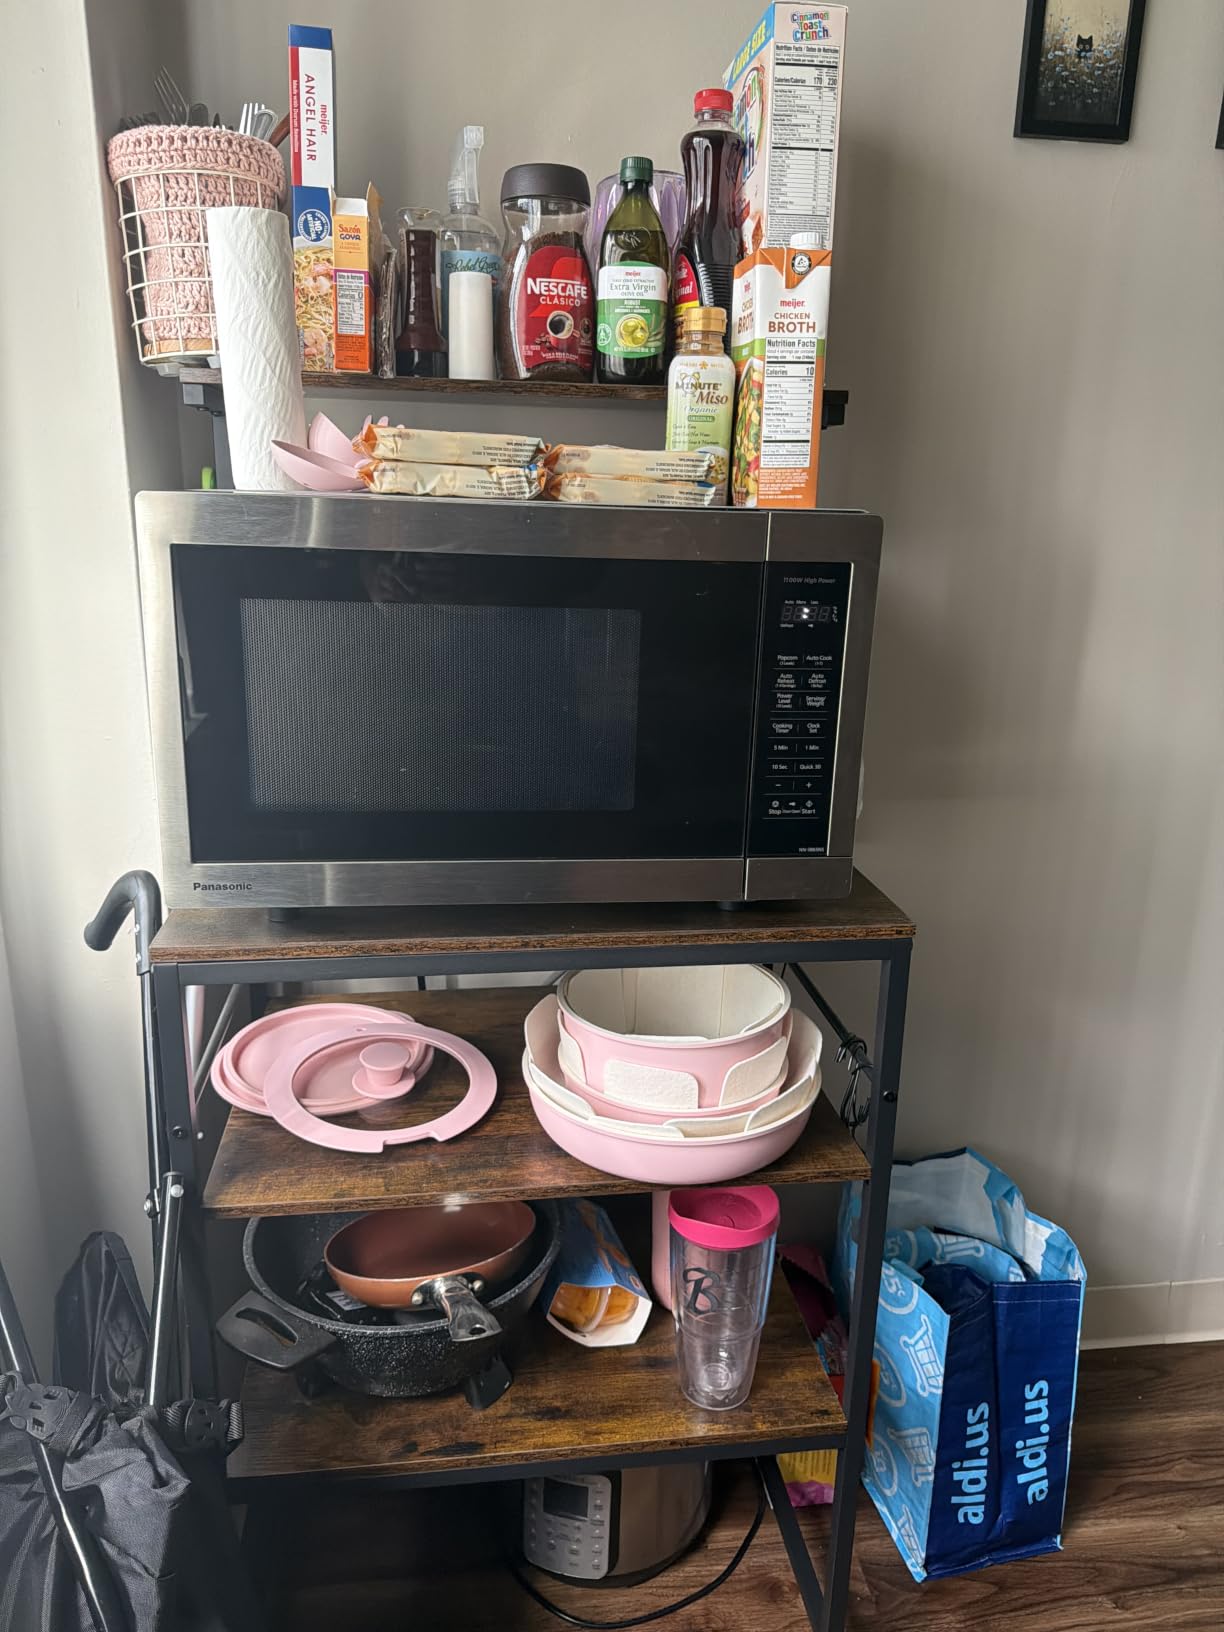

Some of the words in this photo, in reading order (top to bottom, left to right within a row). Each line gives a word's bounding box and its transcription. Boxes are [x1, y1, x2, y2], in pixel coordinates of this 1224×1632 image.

[791, 11, 829, 22] Cinnamon
[798, 20, 823, 31] Toast
[751, 19, 767, 56] SIZE
[793, 26, 829, 42] Crunch
[304, 73, 316, 122] ANGEL
[320, 104, 330, 135] meijer
[306, 128, 317, 161] HAIR
[338, 224, 362, 233] Sazón
[339, 233, 362, 241] GOYA
[609, 283, 630, 291] Extra
[632, 283, 657, 294] Virgin
[539, 296, 581, 307] CLÁSICO
[780, 299, 805, 309] meijer
[774, 312, 811, 320] CHICKEN
[768, 321, 816, 334] BROTH
[767, 339, 796, 348] Nutrition
[797, 340, 816, 348] Facts
[766, 368, 788, 376] Calories
[805, 366, 815, 376] 10
[675, 382, 721, 391] MINUTE
[695, 391, 729, 405] Miso
[684, 405, 718, 414] Organic
[777, 654, 799, 662] Popcorn
[772, 722, 793, 730] Cooking
[768, 808, 782, 816] Stop
[193, 882, 253, 891] Panasonic
[682, 1267, 721, 1315] B
[1015, 1379, 1050, 1506] aldi.us
[950, 1401, 990, 1525] aldi.us
